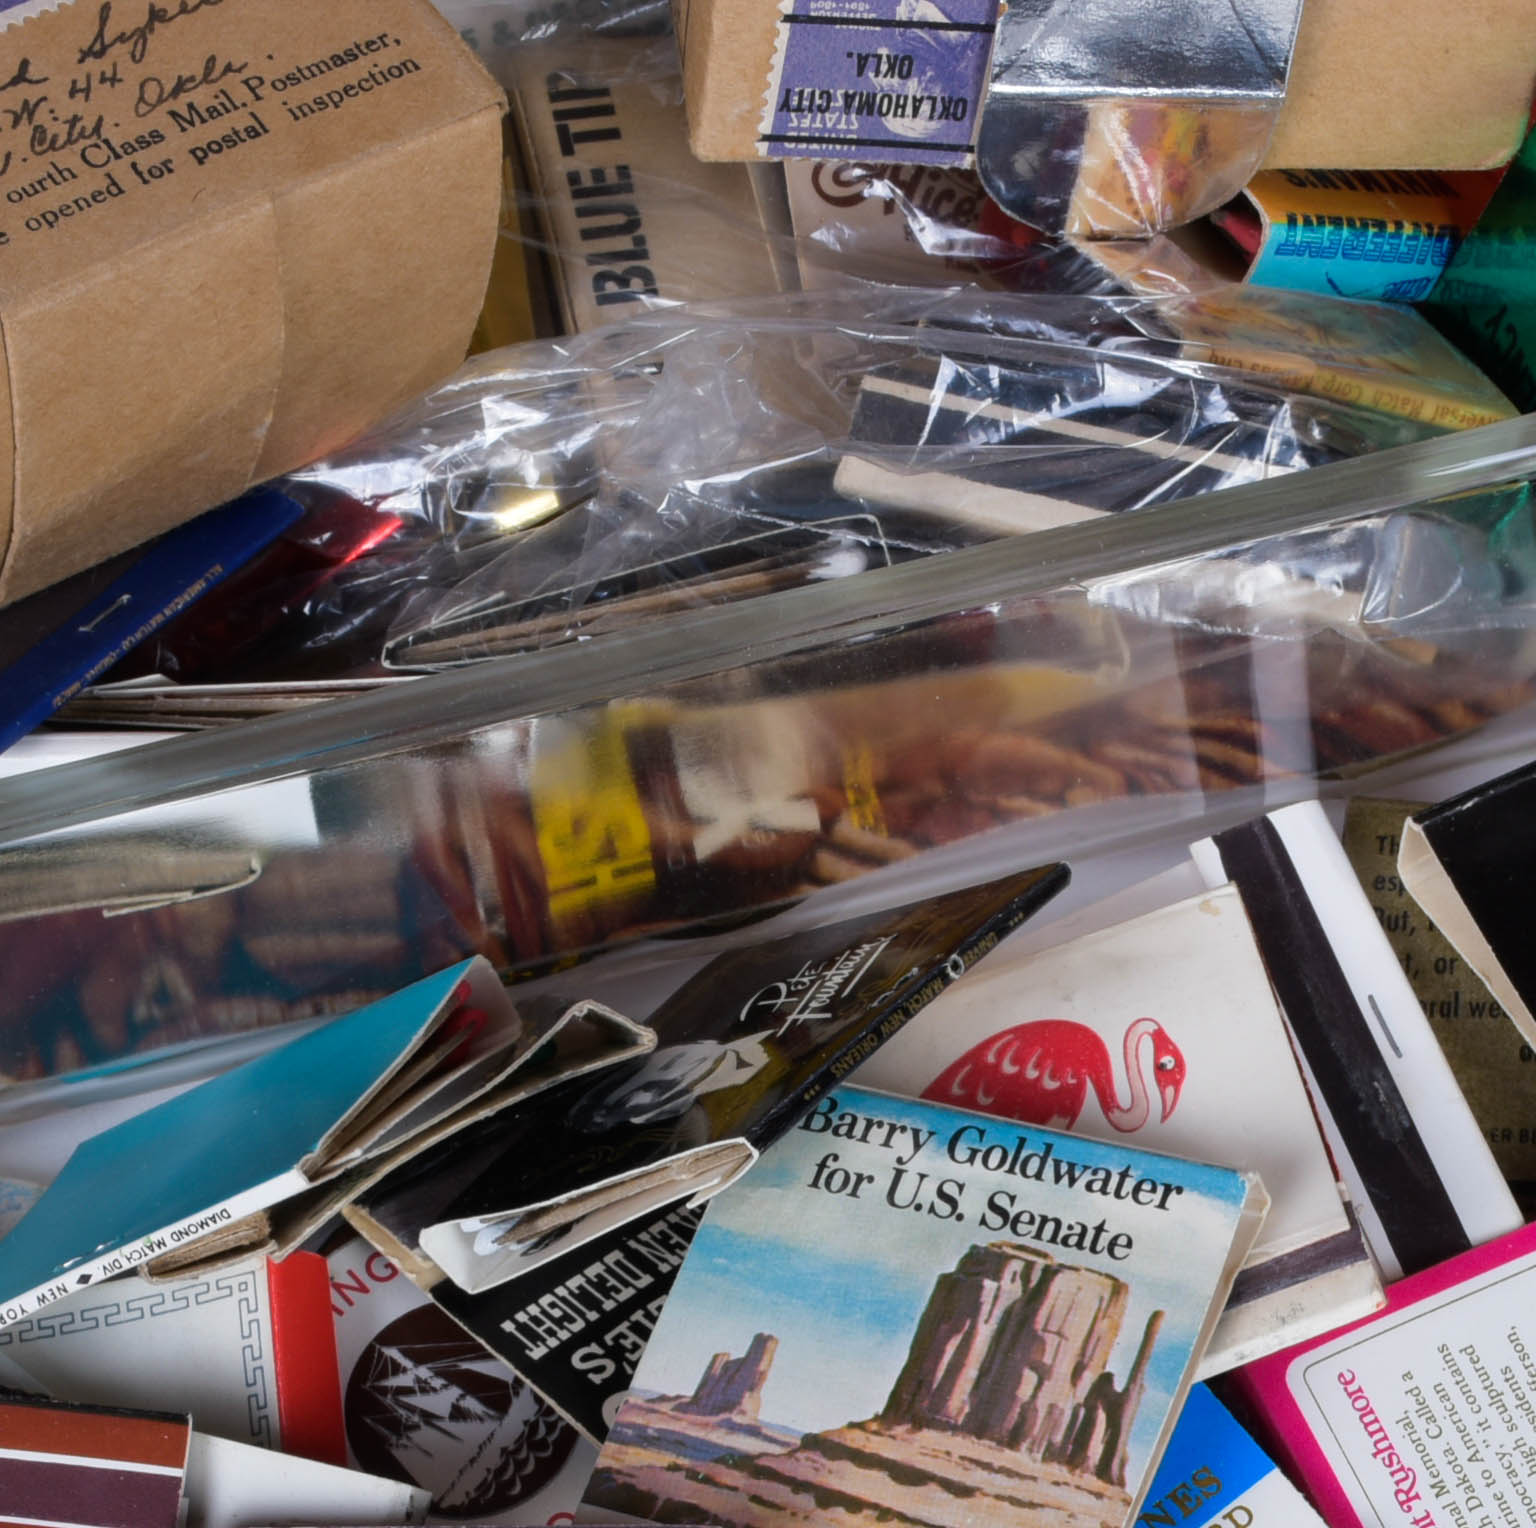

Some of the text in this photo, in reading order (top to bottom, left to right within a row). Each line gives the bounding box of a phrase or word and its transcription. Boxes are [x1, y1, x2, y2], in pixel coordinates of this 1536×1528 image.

[67, 63, 124, 101] 44
[79, 126, 167, 173] Class
[248, 32, 403, 103] Postmaster,
[846, 49, 914, 79] OKLA.
[22, 183, 125, 233] opened
[280, 56, 422, 122] inspection
[565, 164, 659, 307] BLUE
[740, 960, 823, 1022] Pete
[776, 934, 897, 1038] Fountain
[831, 1032, 878, 1078] ORLEANS
[798, 1095, 1184, 1212] Barry Goldwater
[126, 1207, 232, 1265] DIAMOND MATCH
[808, 1152, 1134, 1262] for U.S. Senate
[499, 1249, 656, 1361] DELIGHT
[1433, 1380, 1485, 1465] American
[1436, 1343, 1483, 1417] contains
[1460, 1343, 1520, 1434] sculptured
[1337, 1368, 1420, 1517] Rushmore
